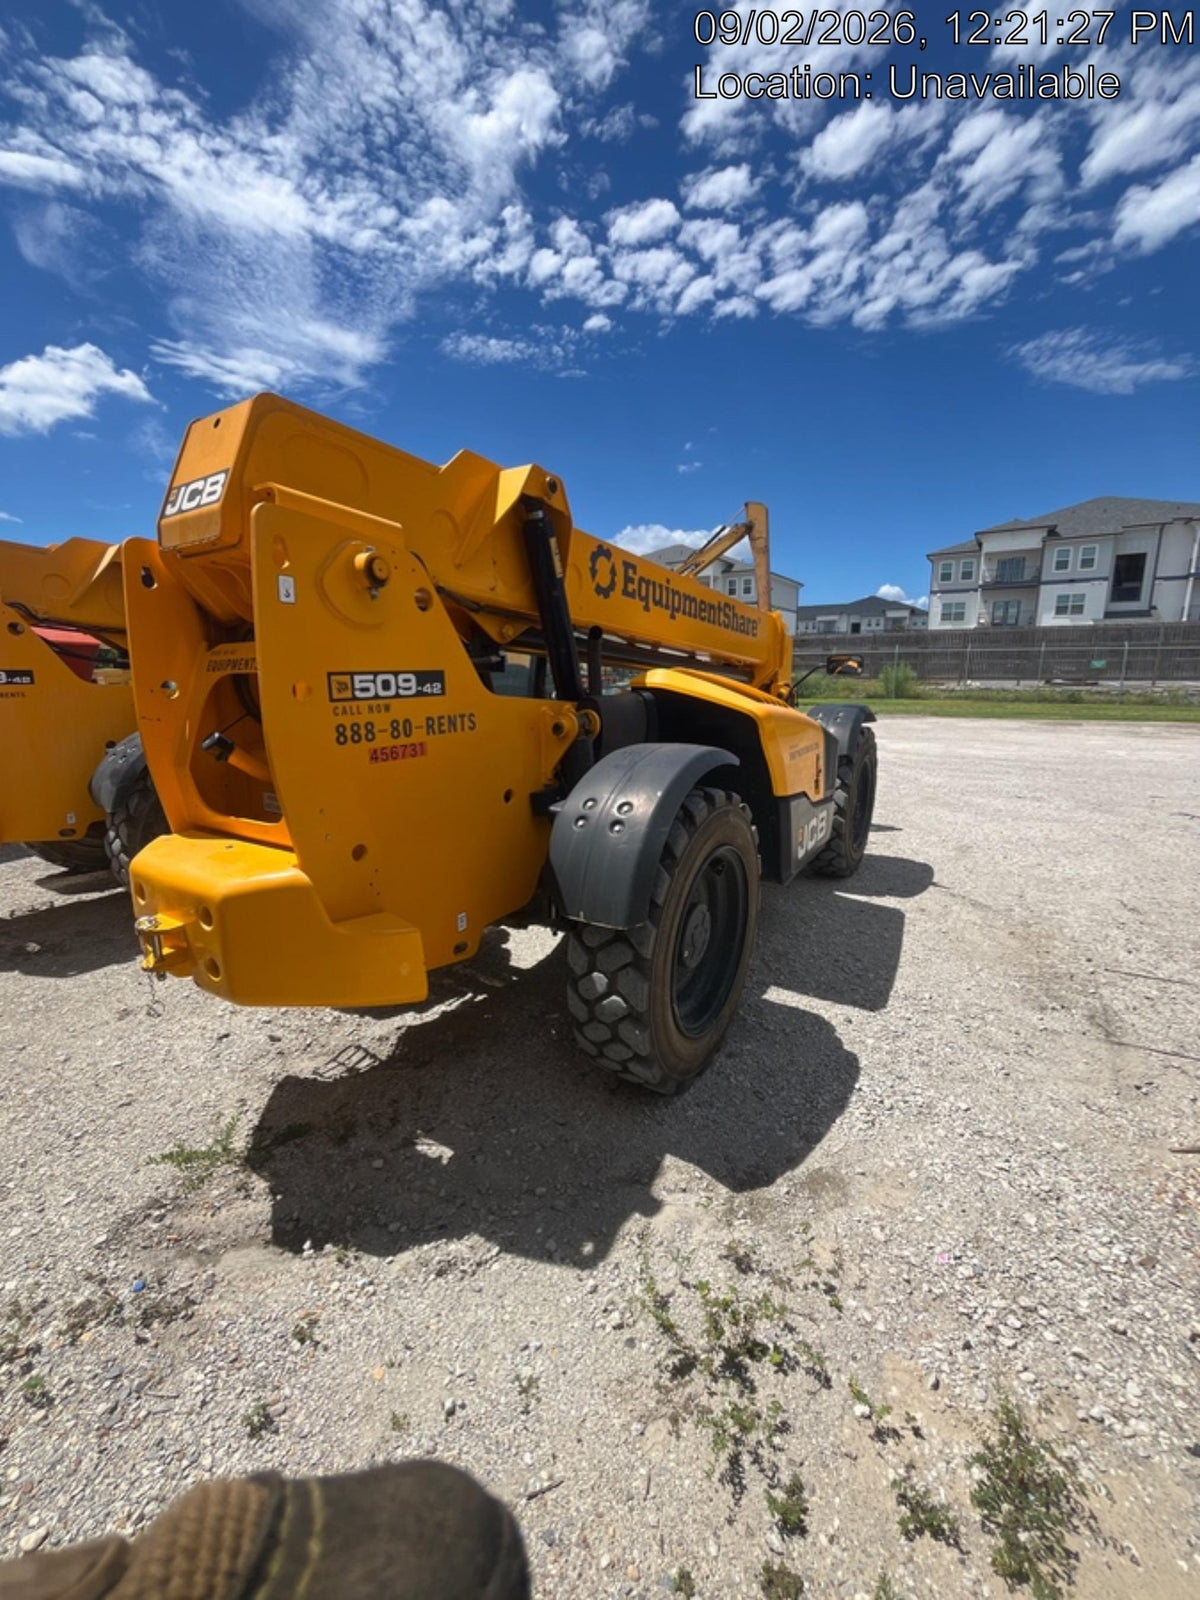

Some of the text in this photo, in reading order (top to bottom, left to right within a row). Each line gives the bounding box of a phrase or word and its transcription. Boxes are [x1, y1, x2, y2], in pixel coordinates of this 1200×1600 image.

[164, 472, 227, 517] JCB
[622, 559, 759, 638] EquipmentShare
[352, 673, 442, 698] 509-42
[332, 703, 392, 717] CALL NOW
[335, 713, 477, 746] 888-80-RENTS
[369, 742, 426, 764] 456731
[797, 810, 828, 860] JCB
